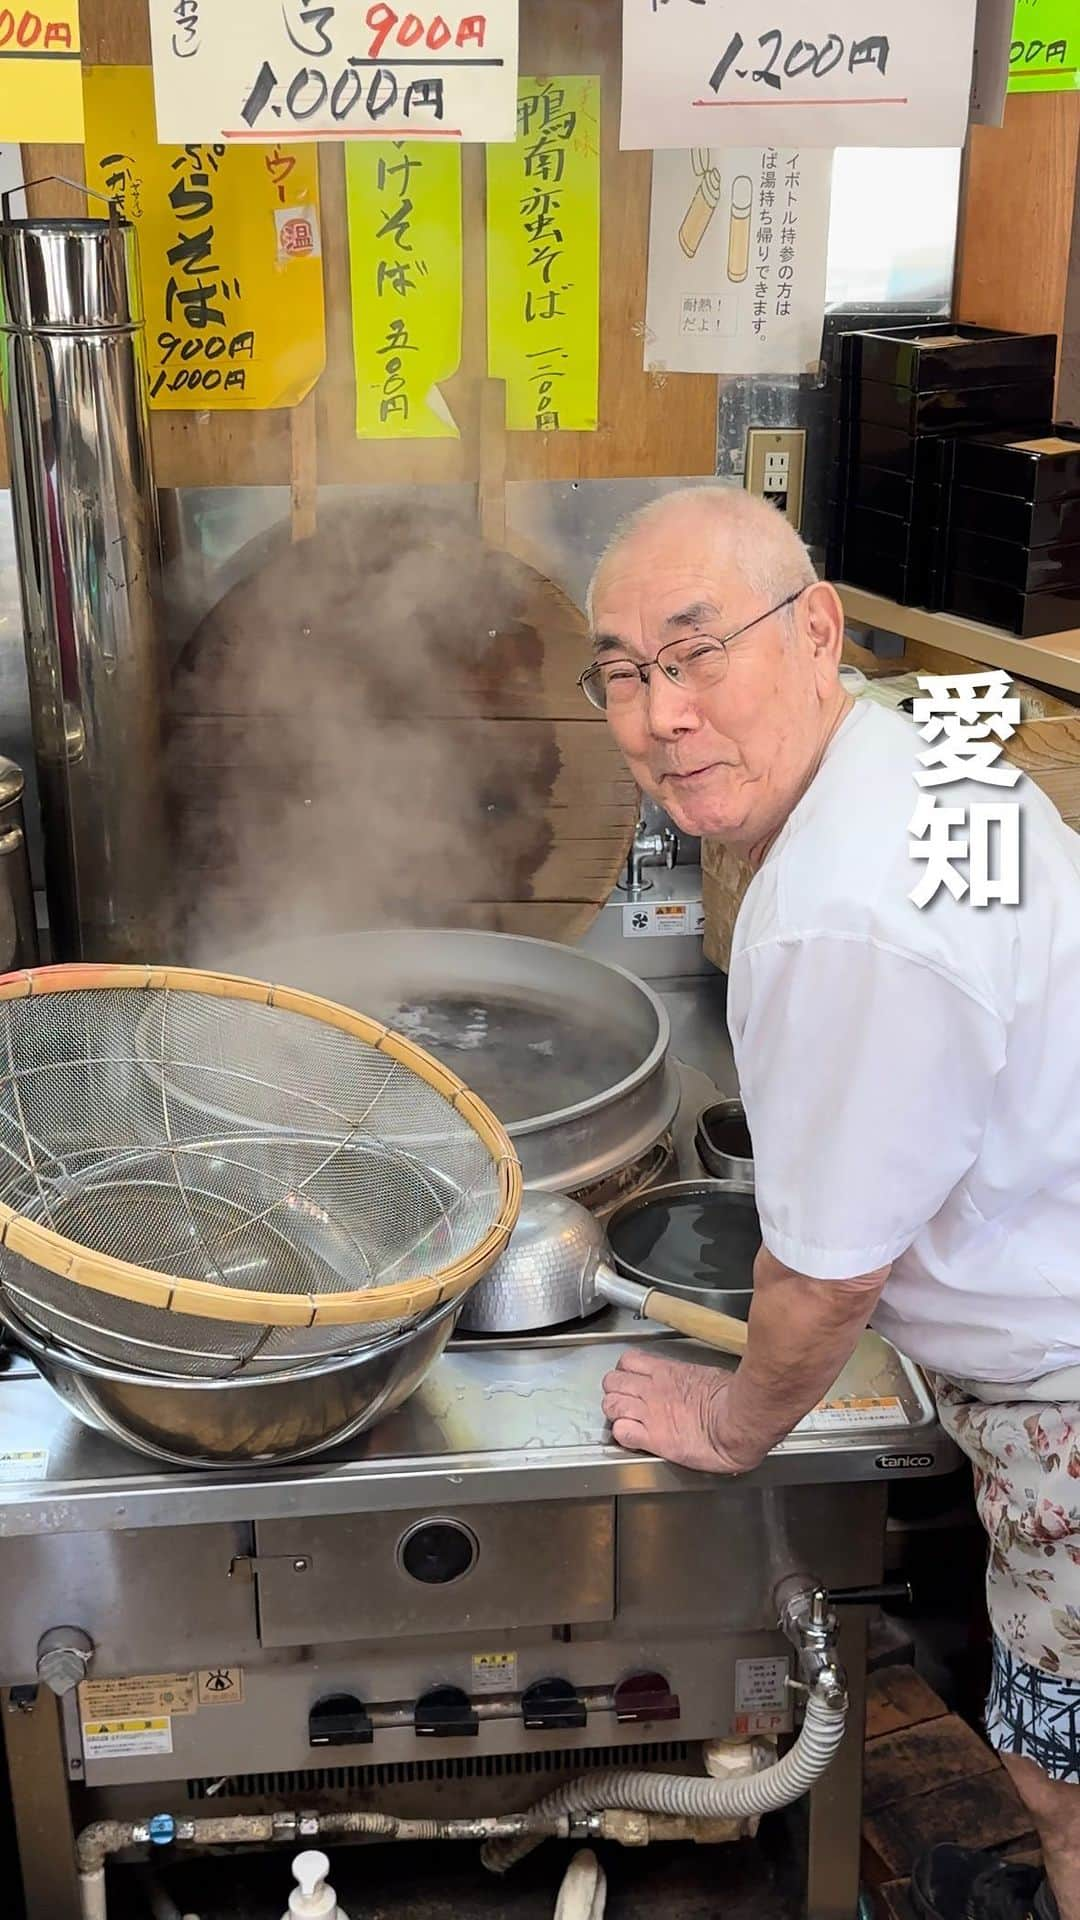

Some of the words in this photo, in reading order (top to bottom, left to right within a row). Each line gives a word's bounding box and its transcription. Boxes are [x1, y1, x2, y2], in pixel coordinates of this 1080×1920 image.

[365, 2, 487, 58] 900円
[264, 144, 297, 203] ウー
[283, 221, 315, 253] 温
[375, 141, 429, 297] けそば
[751, 147, 779, 342] ば湯持ち帰りできます。
[157, 331, 255, 365] 900円
[880, 1455, 932, 1468] tanico
